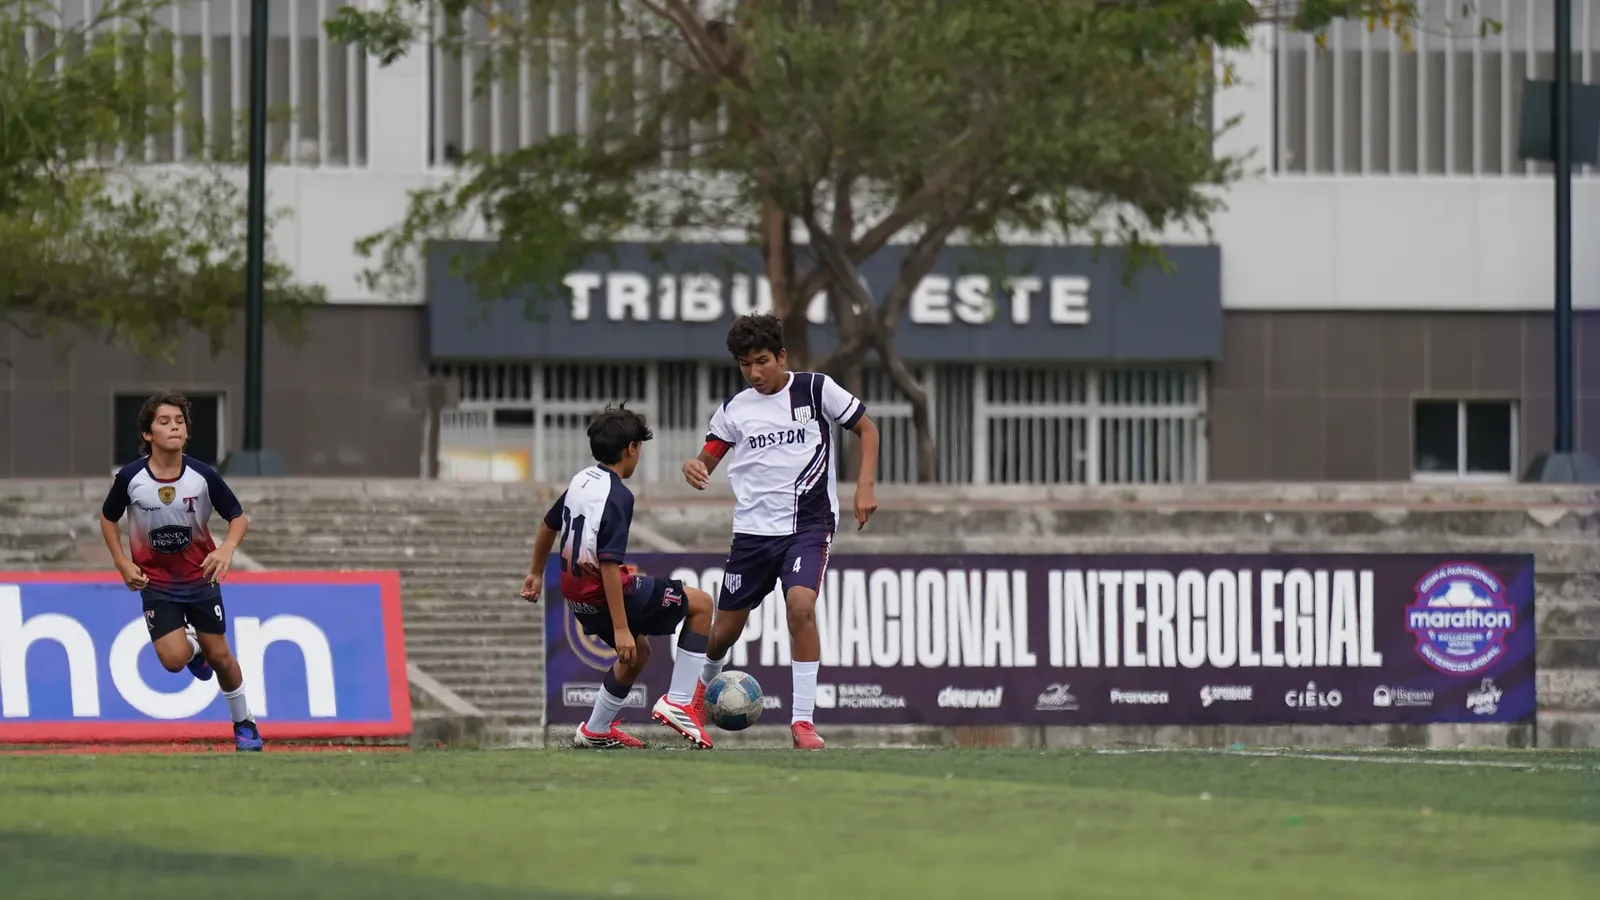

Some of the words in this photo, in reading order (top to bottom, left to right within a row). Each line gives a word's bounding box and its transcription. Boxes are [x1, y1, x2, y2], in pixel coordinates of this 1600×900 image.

[563, 272, 877, 324] TRIBU
[909, 273, 1090, 324] ESTE
[749, 428, 806, 449] BOSTON
[152, 536, 189, 547] PRISCILA
[156, 531, 184, 540] SANTA
[792, 556, 802, 573] 4
[213, 604, 223, 621] 9
[815, 568, 1037, 668] NACIONAL
[1047, 569, 1383, 668] INTERCOLEGIAL
[1409, 608, 1512, 629] marathon
[0, 585, 337, 719] hon
[567, 689, 642, 704] maon
[838, 684, 882, 696] BANCO
[838, 696, 906, 708] PICHINCHA
